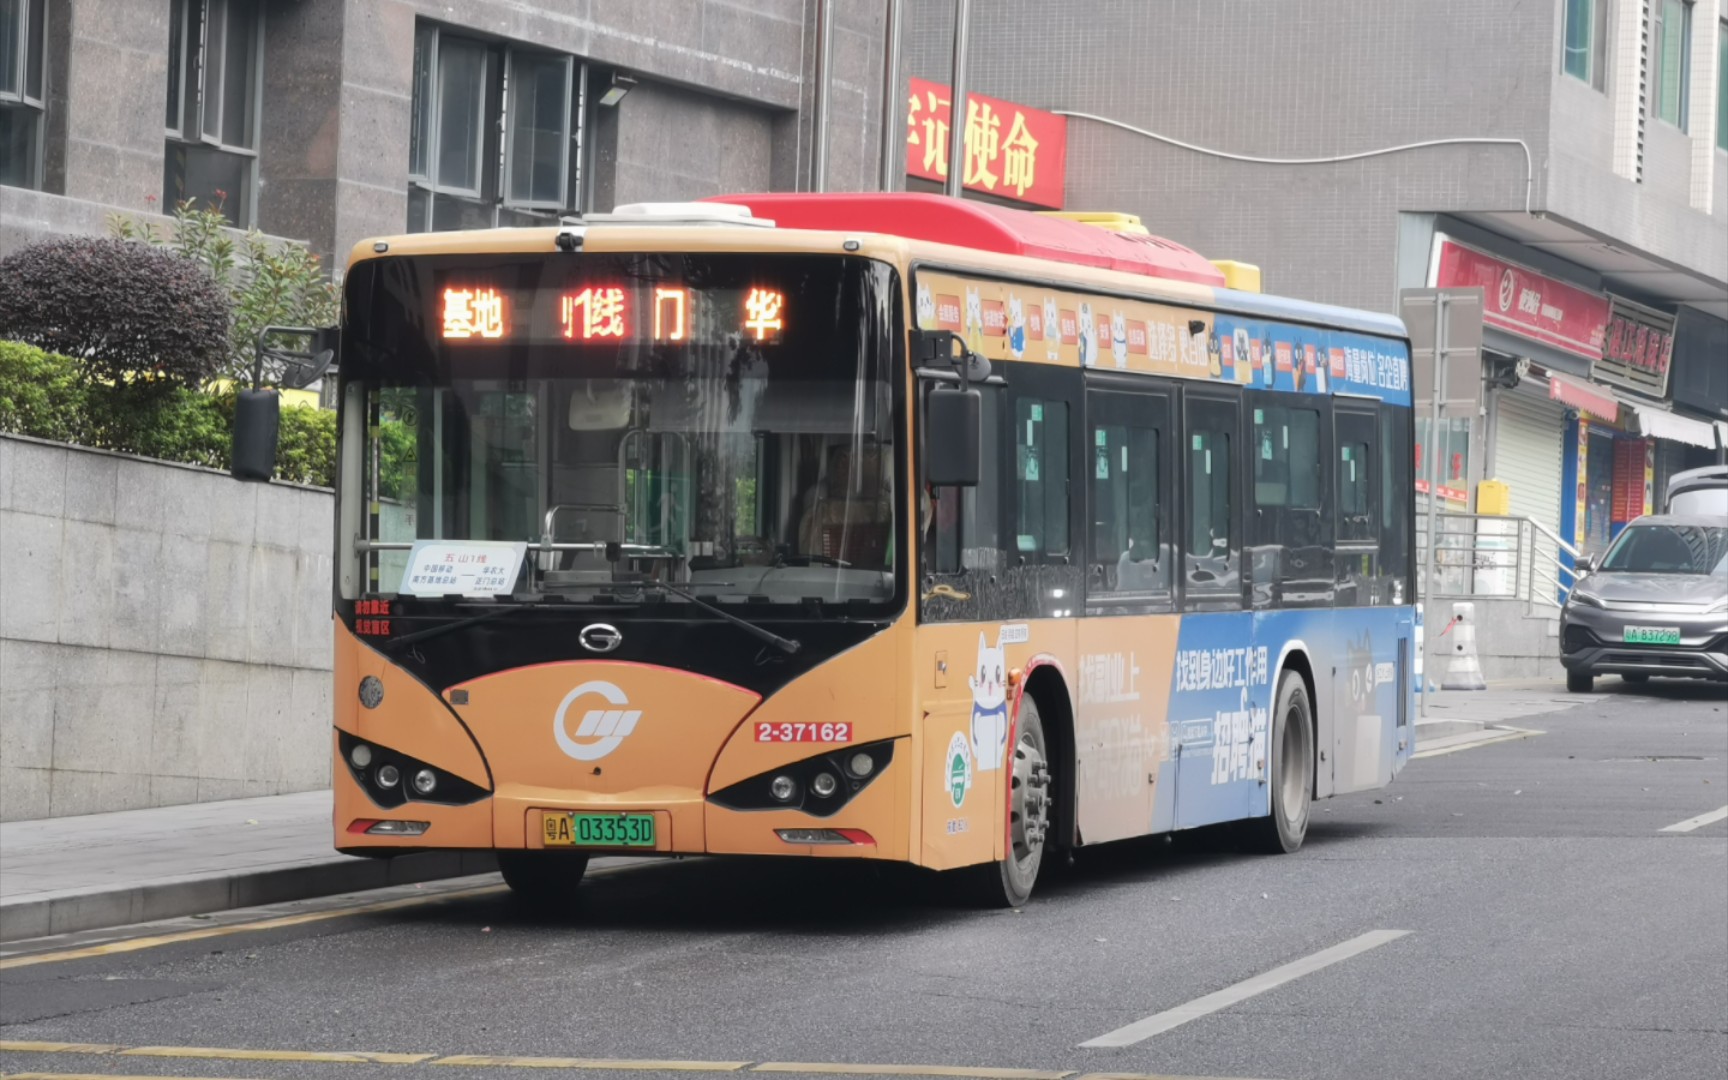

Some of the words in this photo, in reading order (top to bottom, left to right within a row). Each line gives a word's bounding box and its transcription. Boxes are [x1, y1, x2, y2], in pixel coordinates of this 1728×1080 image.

[443, 288, 503, 338] 基地
[745, 288, 782, 340] 华
[1176, 646, 1268, 692] 找到身边好工作用
[758, 722, 848, 742] 2-37162
